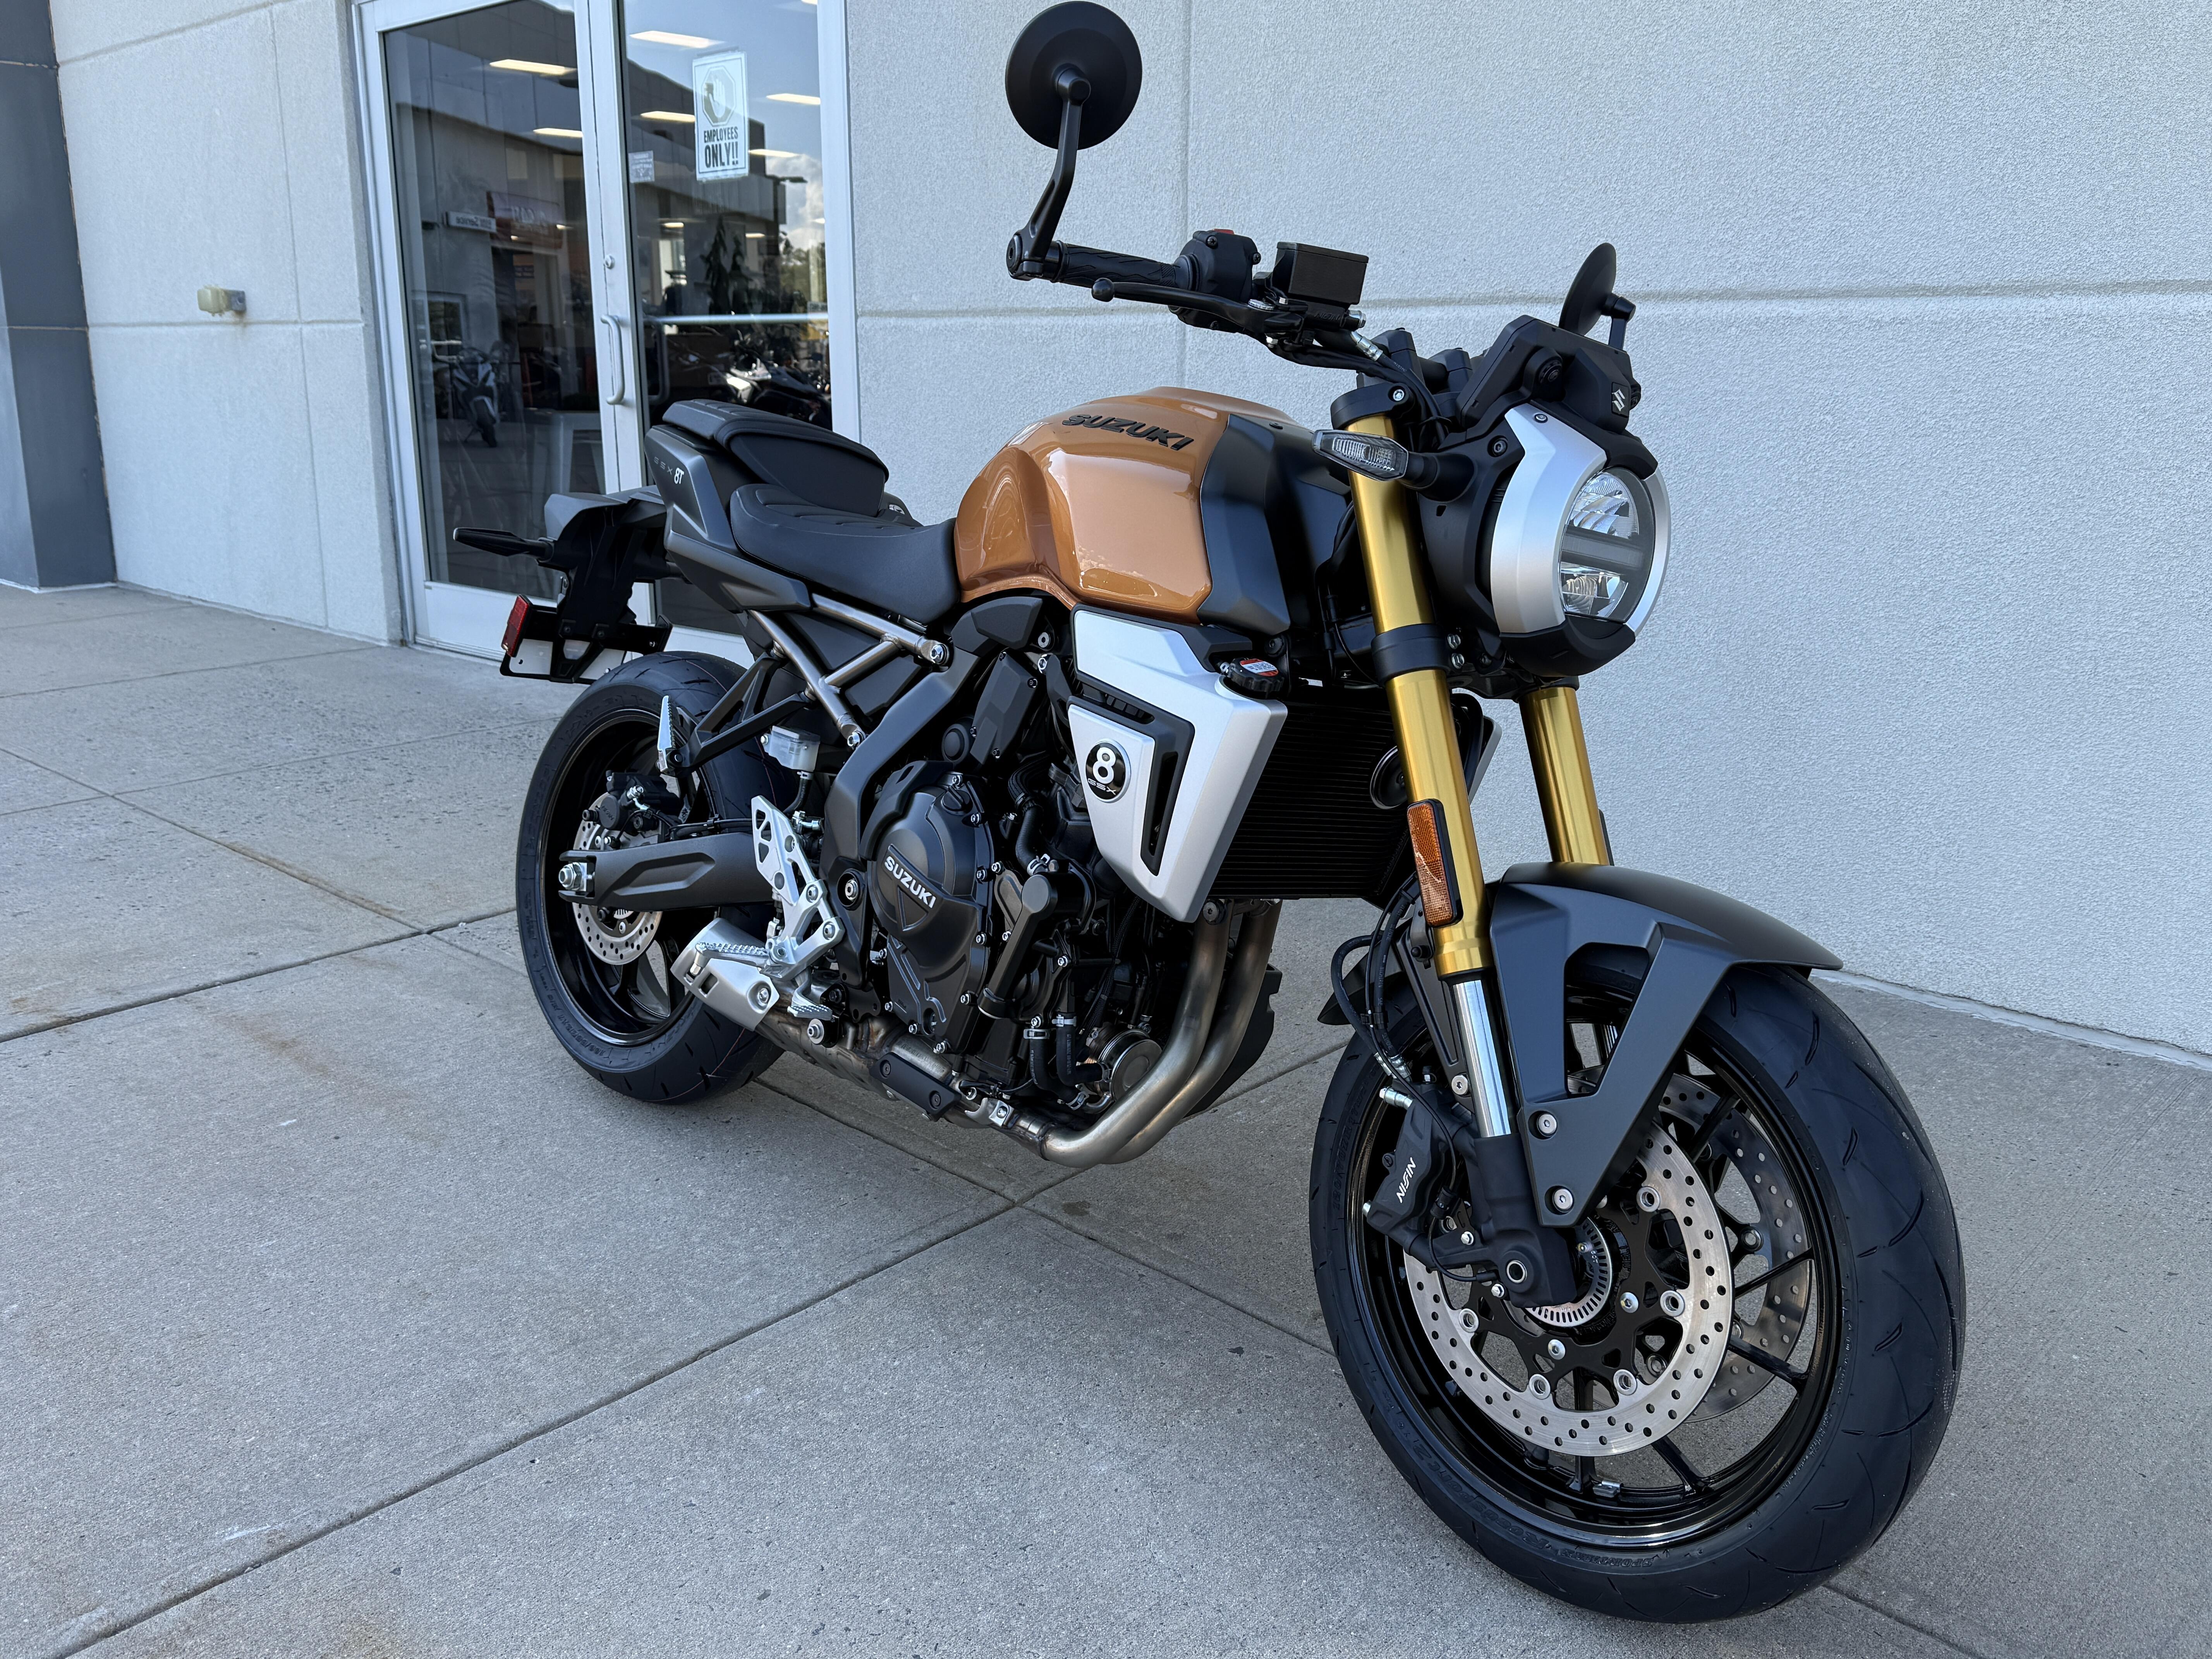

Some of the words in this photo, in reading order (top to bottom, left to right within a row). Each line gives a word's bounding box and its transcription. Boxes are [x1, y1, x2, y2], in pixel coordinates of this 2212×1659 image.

[704, 126, 738, 143] EMPLOYEES
[705, 141, 738, 168] ONLY!!
[1062, 414, 1194, 450] SUZUKI
[654, 457, 673, 476] GSX
[674, 467, 684, 484] 8T
[1093, 747, 1116, 784] 8
[1088, 778, 1116, 795] GSX
[884, 856, 936, 908] SUZUKI
[1396, 1157, 1416, 1203] NISSIN
